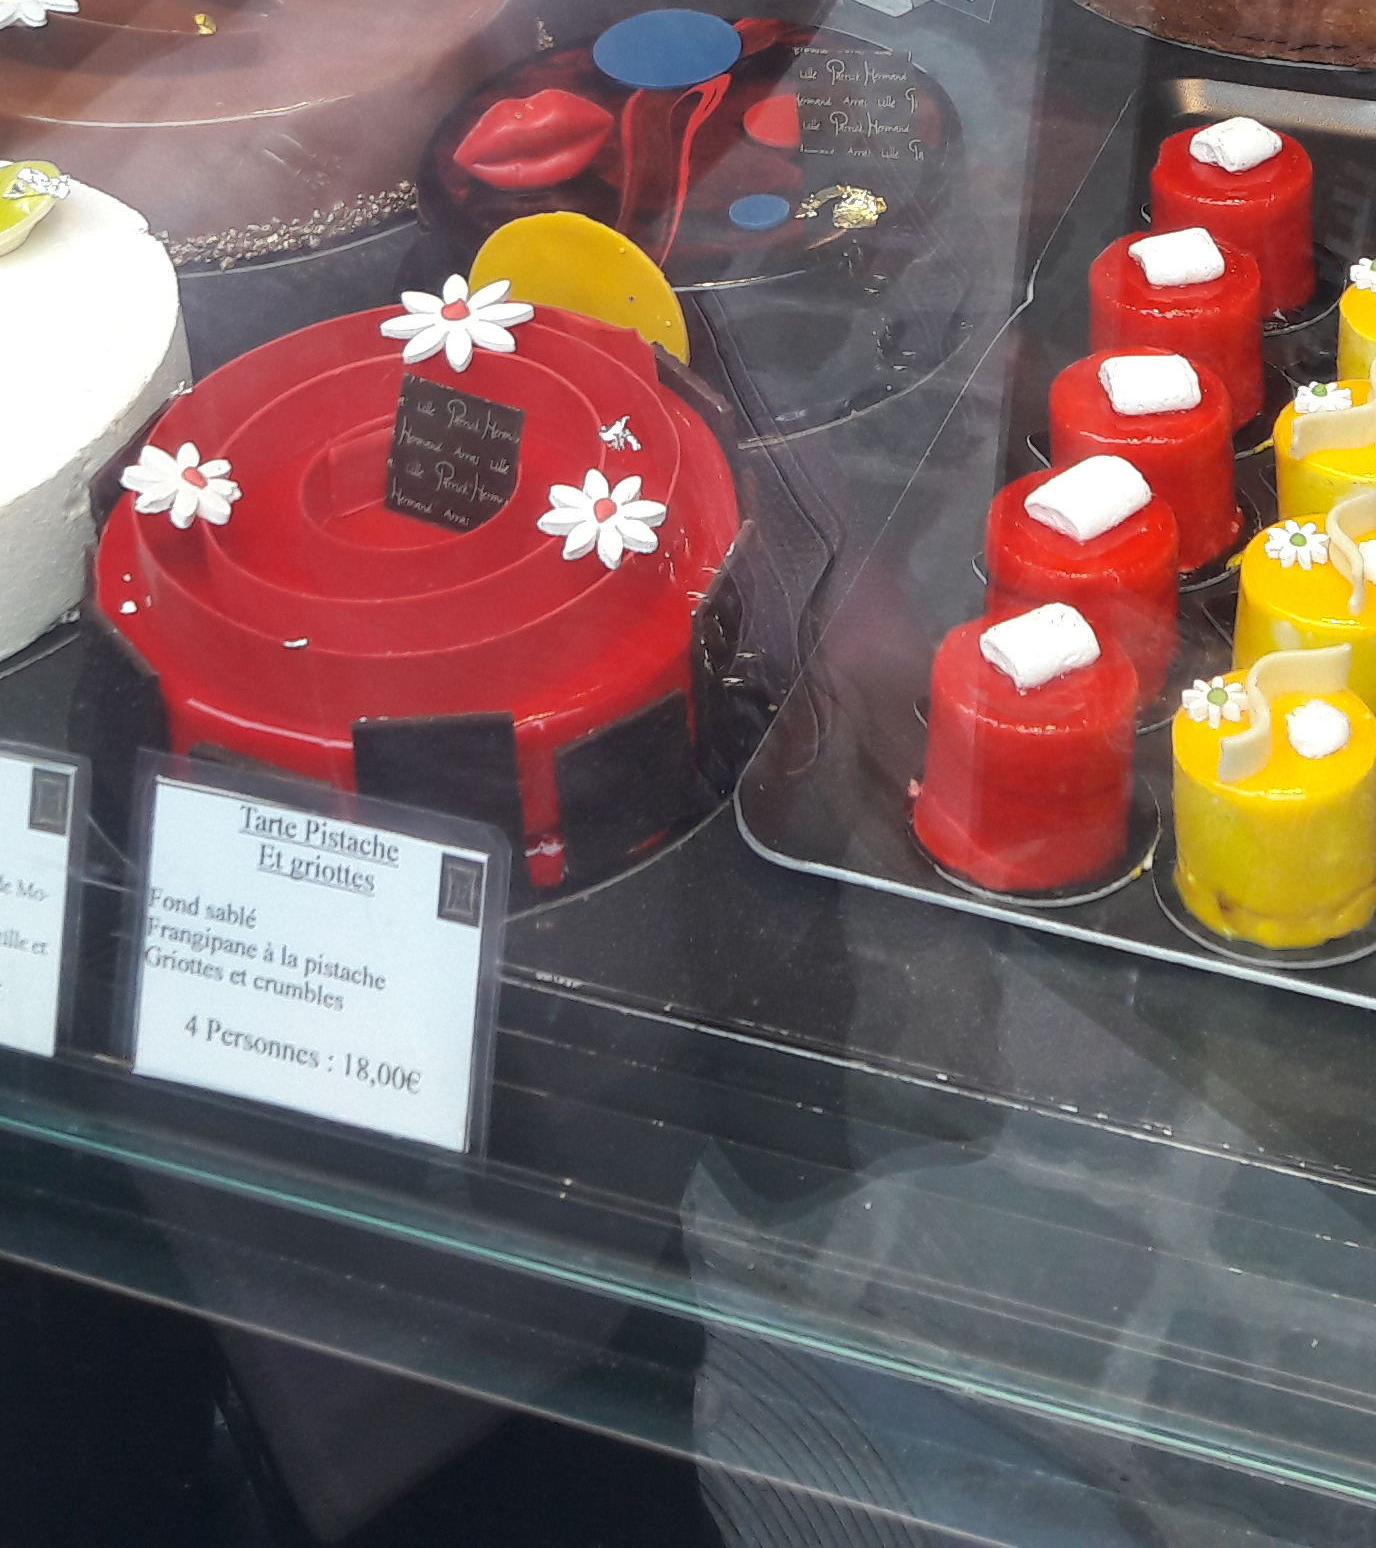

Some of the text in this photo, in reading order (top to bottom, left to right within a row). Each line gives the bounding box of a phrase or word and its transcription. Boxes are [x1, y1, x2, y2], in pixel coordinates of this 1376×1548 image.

[241, 806, 398, 861] Tarte Pistache
[260, 844, 374, 892] Et griottes
[148, 884, 256, 929] Fond sablé
[143, 945, 343, 1009] Griottes et crumbles
[145, 913, 385, 990] Frangipane à la pistache
[184, 1016, 198, 1037] 4
[207, 1019, 318, 1067] Personnes
[346, 1054, 420, 1093] 18,00€
